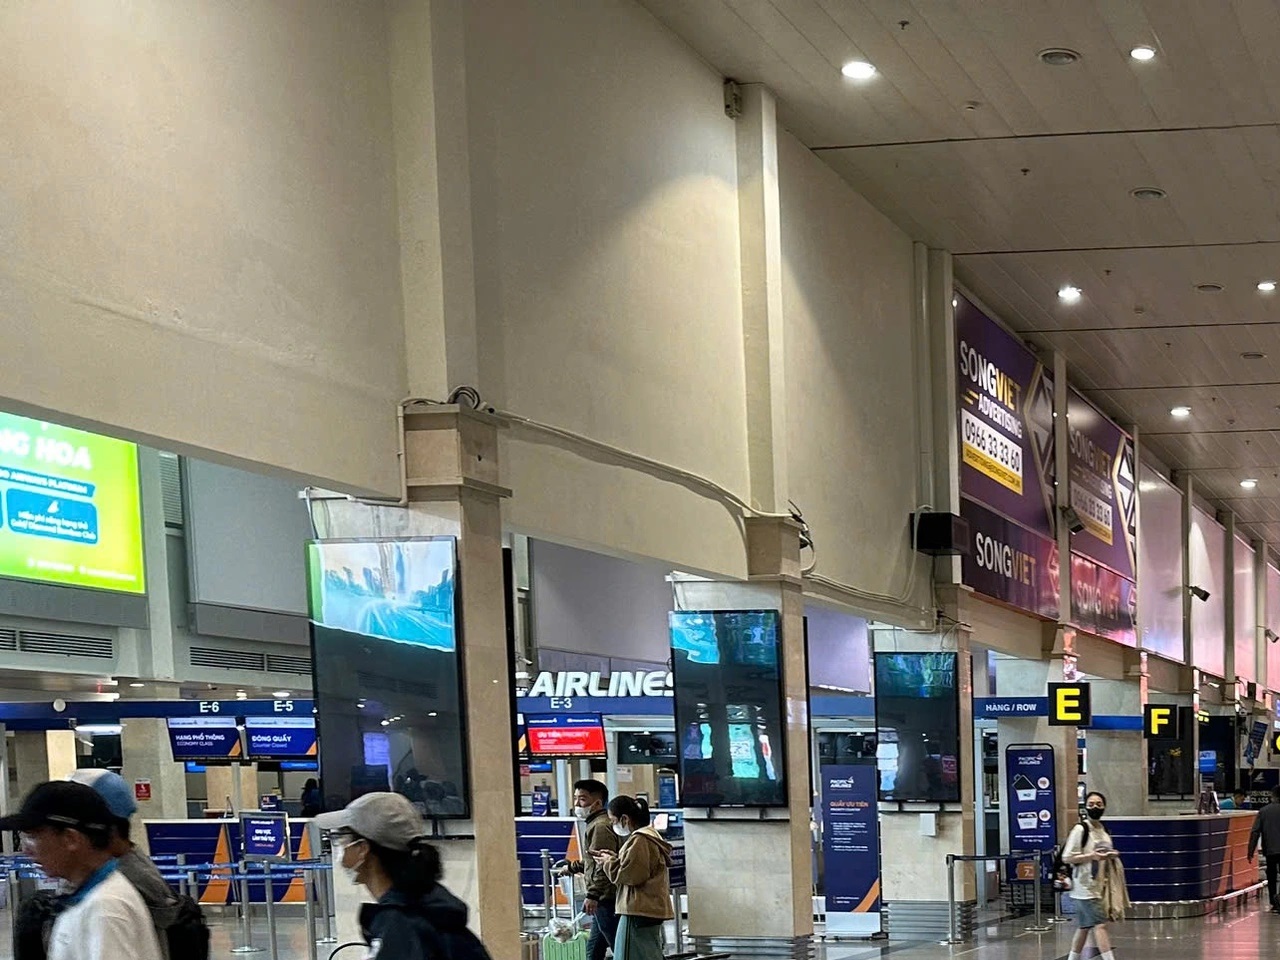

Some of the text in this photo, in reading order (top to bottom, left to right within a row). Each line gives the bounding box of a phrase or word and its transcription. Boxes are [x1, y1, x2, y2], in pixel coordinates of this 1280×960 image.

[960, 341, 1022, 414] SONGVIET
[977, 393, 1022, 439] ADVERTISING
[965, 418, 1020, 472] 0966 33 33 60
[976, 532, 1037, 587] SONGVIET
[1076, 580, 1120, 621] SONGVIET
[199, 702, 219, 713] E-6
[273, 700, 293, 712] E-5
[550, 698, 572, 709] E-3
[985, 703, 1010, 712] HÀNG
[1016, 703, 1037, 711] ROW
[1056, 688, 1082, 721] E
[1150, 708, 1171, 735] F
